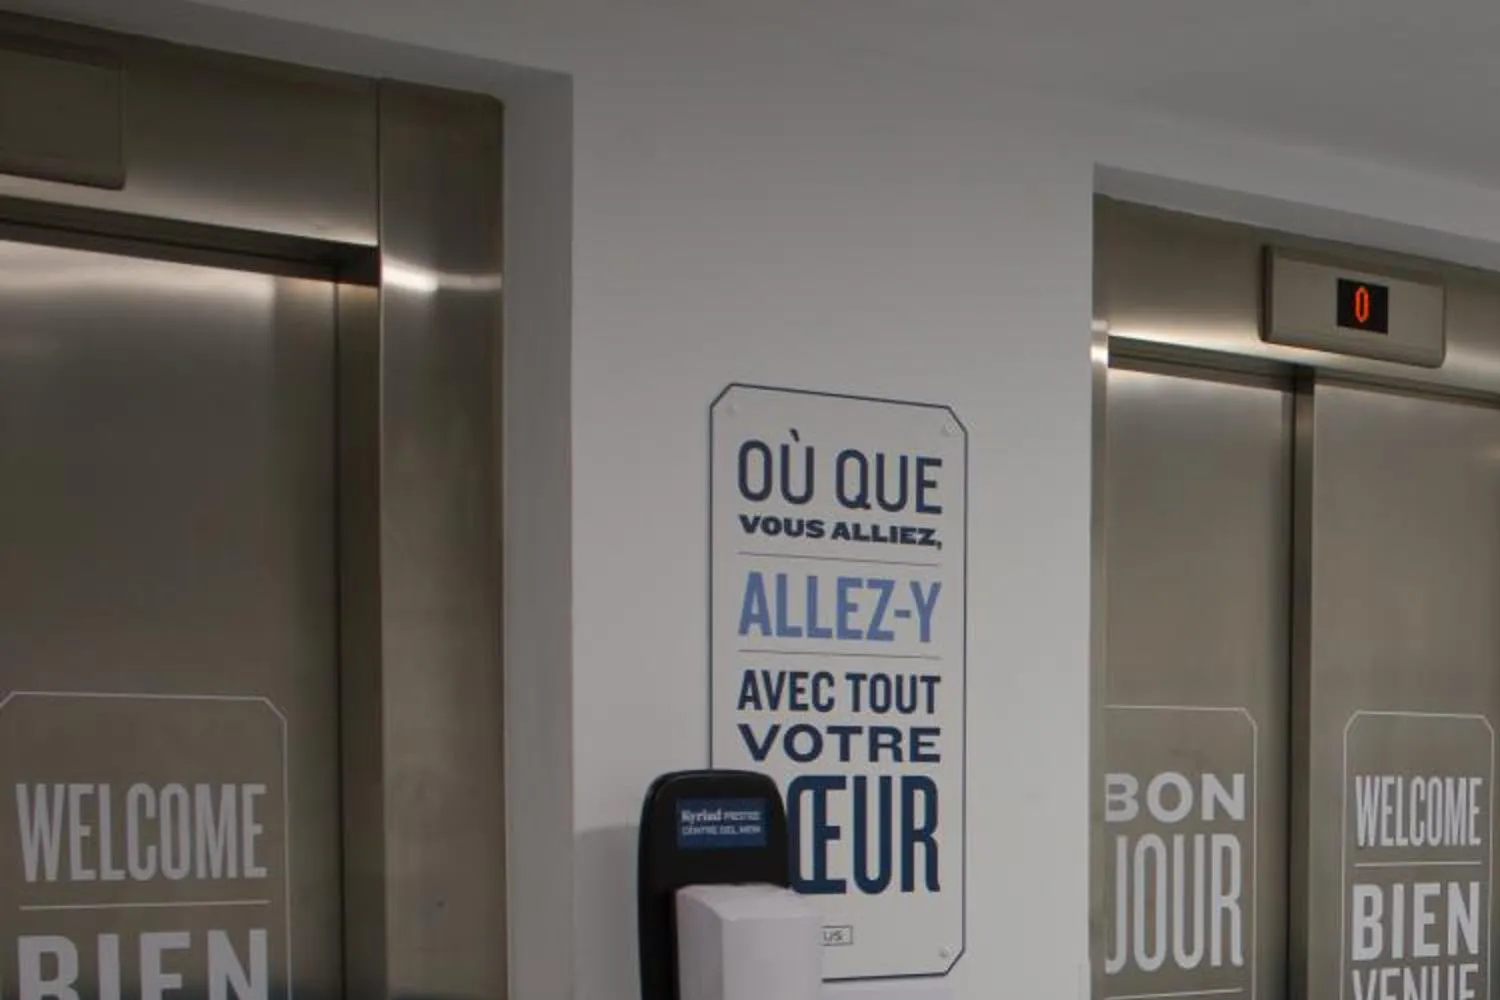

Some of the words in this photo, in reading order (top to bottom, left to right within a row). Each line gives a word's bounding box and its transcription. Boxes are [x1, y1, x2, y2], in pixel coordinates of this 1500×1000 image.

[1354, 285, 1370, 324] 0
[738, 429, 814, 504] OÙ
[836, 448, 943, 514] QUE
[738, 514, 825, 539] VOUS
[831, 522, 943, 549] ALLIEZ,
[738, 571, 942, 643] ALLEZ-Y
[737, 669, 835, 713] AVEC
[845, 672, 942, 715] TOUT
[738, 724, 942, 763] VOTRE
[16, 782, 268, 883] WELCOME
[1104, 772, 1245, 823] BON
[1354, 775, 1483, 848] WELCOME
[786, 775, 942, 896] ŒUR
[1104, 833, 1244, 975] JOUR
[1352, 881, 1480, 962] BIEN
